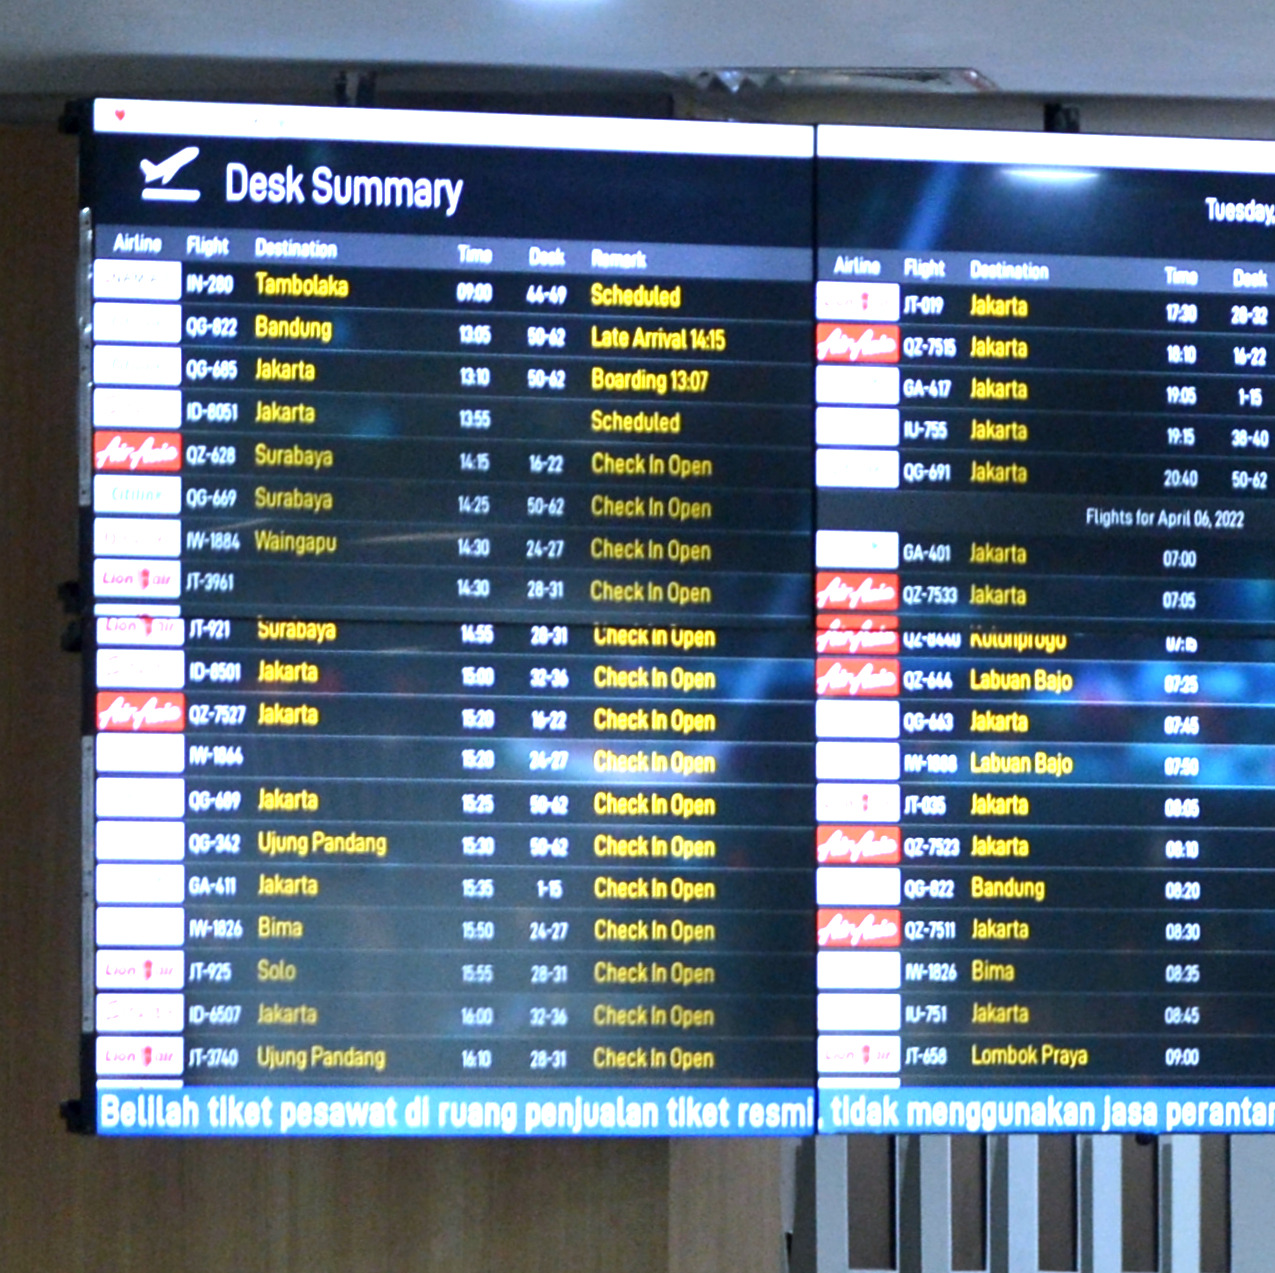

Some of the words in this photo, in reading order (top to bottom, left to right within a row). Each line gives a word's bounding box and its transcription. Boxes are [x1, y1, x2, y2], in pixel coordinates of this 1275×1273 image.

[226, 162, 305, 204] Desk
[312, 165, 464, 217] Summary
[113, 233, 162, 253] Airline
[186, 235, 229, 257] Flight
[255, 237, 338, 259] Destination
[834, 256, 881, 275] Airline
[904, 257, 945, 279] Flight
[970, 259, 1049, 280] Destination
[254, 270, 350, 298] Tambolaka
[590, 281, 682, 309] Scheduled
[969, 293, 1029, 318] Jakarta
[254, 314, 333, 344] Bandung
[590, 325, 631, 349] Late
[631, 326, 688, 351] Arrival
[689, 328, 727, 352] 14:15
[969, 335, 1029, 359] Jakarta
[255, 357, 316, 382] Jakarta
[591, 366, 668, 396] Boarding
[669, 369, 709, 393] 13:07
[969, 376, 1029, 400] Jakarta
[255, 400, 316, 424] Jakarta
[590, 409, 681, 434] Scheduled
[903, 420, 948, 440] IU-755
[970, 418, 1028, 441] Jakarta
[1167, 427, 1196, 446] 19:15
[1231, 428, 1270, 448] 38-40
[185, 444, 236, 466] QZ-628
[254, 442, 334, 470] Surabaya
[459, 452, 490, 471] 14:15
[529, 454, 564, 474] 16-22
[591, 451, 646, 475] Check
[648, 453, 665, 475] In
[668, 453, 712, 479] Open
[903, 462, 951, 483] QG-691
[970, 460, 1028, 484] Jakarta
[1163, 469, 1199, 488] 20:40
[1231, 470, 1268, 490] 50-62
[185, 487, 237, 509] QG-669
[254, 485, 333, 513] Surabaya
[458, 495, 490, 514] 14:25
[527, 496, 565, 516] 50-62
[590, 494, 646, 518] Check
[648, 496, 665, 517] In
[667, 496, 712, 522] Open
[1086, 507, 1134, 528] Flights
[1135, 508, 1155, 527] for
[1157, 509, 1191, 529] April
[1193, 509, 1213, 529] 06,
[1214, 509, 1245, 529] 2022
[186, 530, 241, 550] IW-1884
[254, 529, 337, 556] Waingapu
[457, 537, 491, 557] 14:30
[526, 539, 565, 558] 24-27
[590, 537, 645, 560] Check
[647, 539, 664, 560] In
[667, 538, 712, 564] Open
[902, 543, 951, 562] GA-401
[969, 542, 1028, 565] Jakarta
[1162, 549, 1197, 568] 07:00
[185, 571, 234, 592] JT-3961
[456, 578, 490, 597] 14:30
[527, 579, 564, 599] 28-31
[589, 579, 645, 603] Check
[647, 581, 664, 602] In
[666, 581, 712, 606] Open
[902, 585, 958, 606] QZ-7533
[969, 584, 1028, 606] Jakarta
[1162, 590, 1196, 610] 07:05
[257, 659, 319, 684] Jakarta
[969, 668, 1032, 691] Labuan
[1033, 668, 1074, 695] Bajo
[257, 702, 319, 727] Jakarta
[969, 750, 1033, 775] Labuan
[1034, 751, 1074, 778] Bajo
[257, 787, 319, 812] Jakarta
[257, 830, 310, 857] Ujung
[311, 830, 388, 858] Pandang
[257, 873, 319, 896] Jakarta
[593, 875, 650, 900] Check
[650, 877, 669, 899] In
[670, 876, 716, 903] Open
[970, 875, 1046, 902] Bandung
[257, 915, 304, 939] Bima
[593, 918, 649, 942] Check
[651, 919, 668, 941] In
[670, 918, 715, 944] Open
[971, 917, 1030, 940] Jakarta
[256, 958, 297, 982] Solo
[593, 960, 649, 984] Check
[650, 961, 668, 983] In
[670, 961, 715, 987] Open
[971, 958, 1015, 982] Bima
[257, 1002, 318, 1025] Jakarta
[592, 1003, 649, 1027] Check
[650, 1005, 668, 1026] In
[669, 1004, 715, 1029] Open
[971, 1002, 1030, 1024] Jakarta
[257, 1045, 308, 1071] Ujung
[310, 1044, 387, 1072] Pandang
[592, 1046, 649, 1069] Check
[650, 1047, 667, 1068] In
[669, 1046, 715, 1072] Open
[971, 1044, 1038, 1066] Lombok
[1041, 1043, 1089, 1069] Praya
[1165, 1047, 1200, 1066] 09:00
[101, 1093, 200, 1127] Belilah
[207, 1094, 273, 1128] tiket
[280, 1096, 398, 1133] pesawat
[404, 1095, 430, 1128] di
[438, 1101, 518, 1134] ruang
[524, 1095, 659, 1134] penjualan
[666, 1095, 730, 1128] tiket
[829, 1094, 900, 1127] tidak
[907, 1095, 1096, 1132] menggunakan
[1101, 1095, 1158, 1132] jasa
